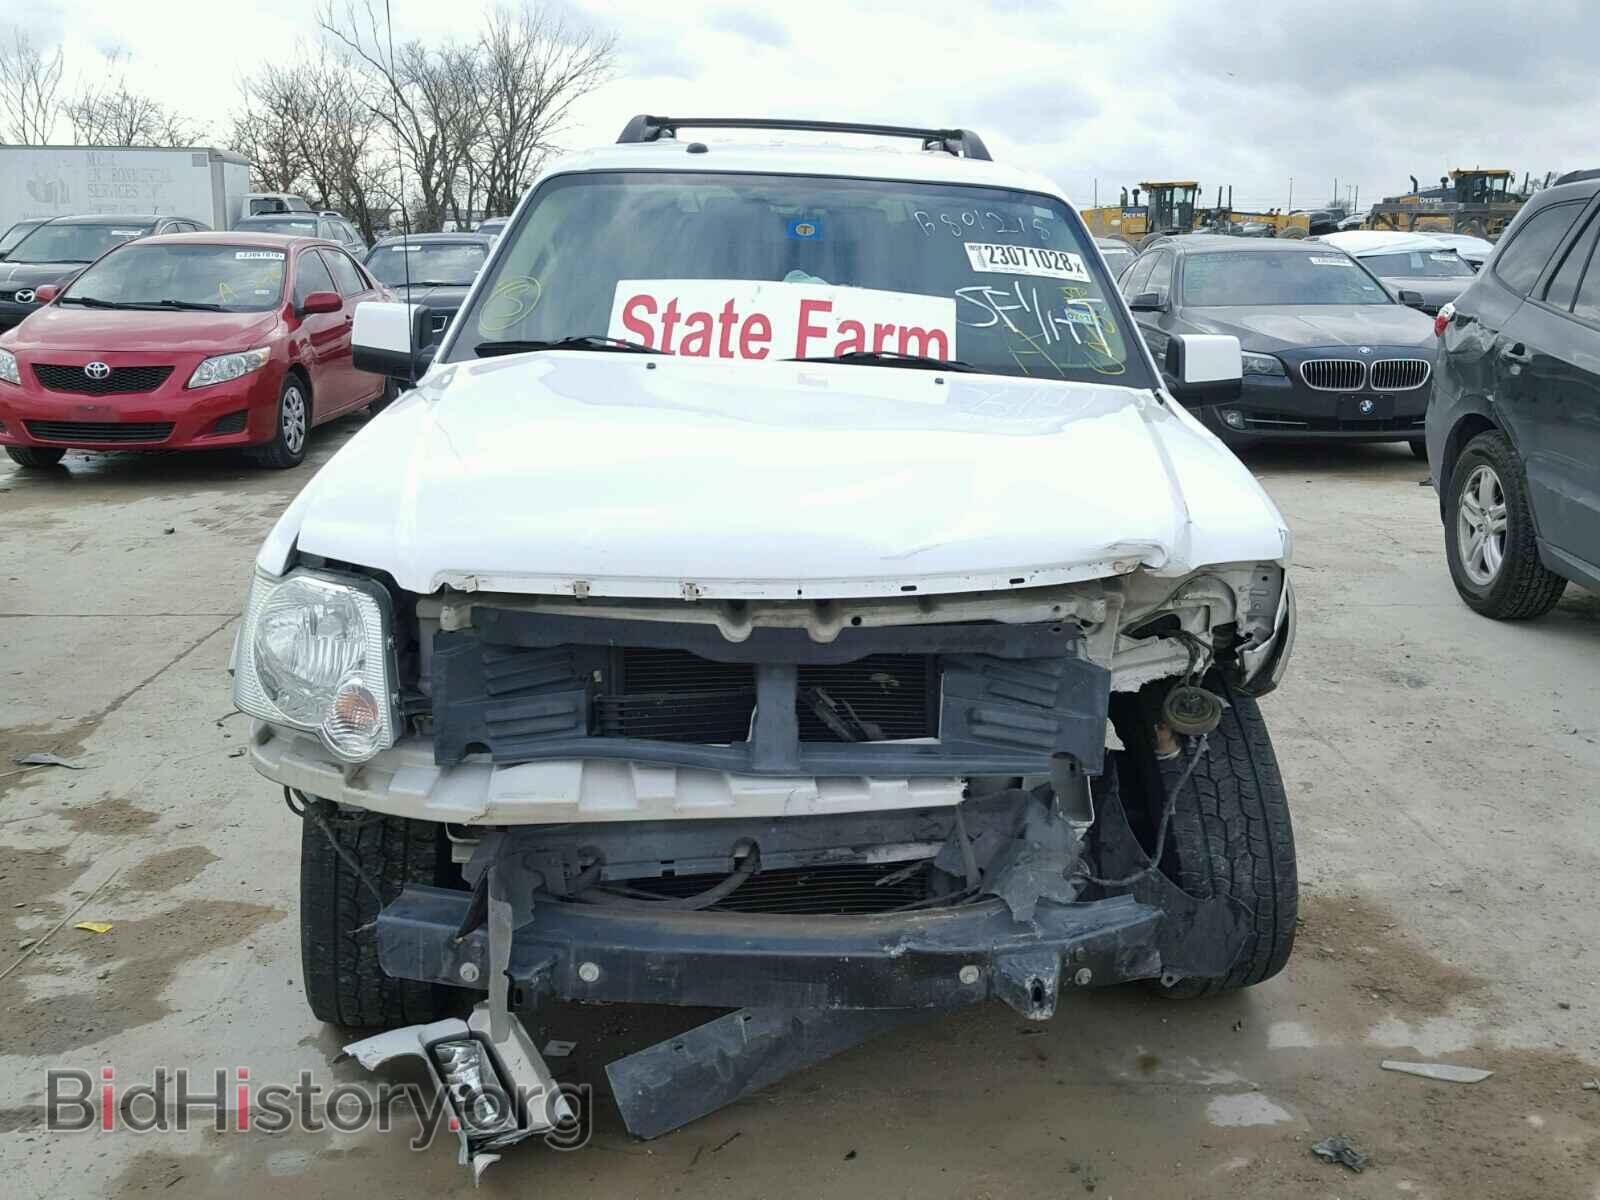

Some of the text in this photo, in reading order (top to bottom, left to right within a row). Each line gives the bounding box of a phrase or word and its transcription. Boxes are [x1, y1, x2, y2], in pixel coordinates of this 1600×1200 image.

[984, 245, 1073, 273] 23071028
[617, 294, 773, 360] State
[795, 299, 949, 361] Farm
